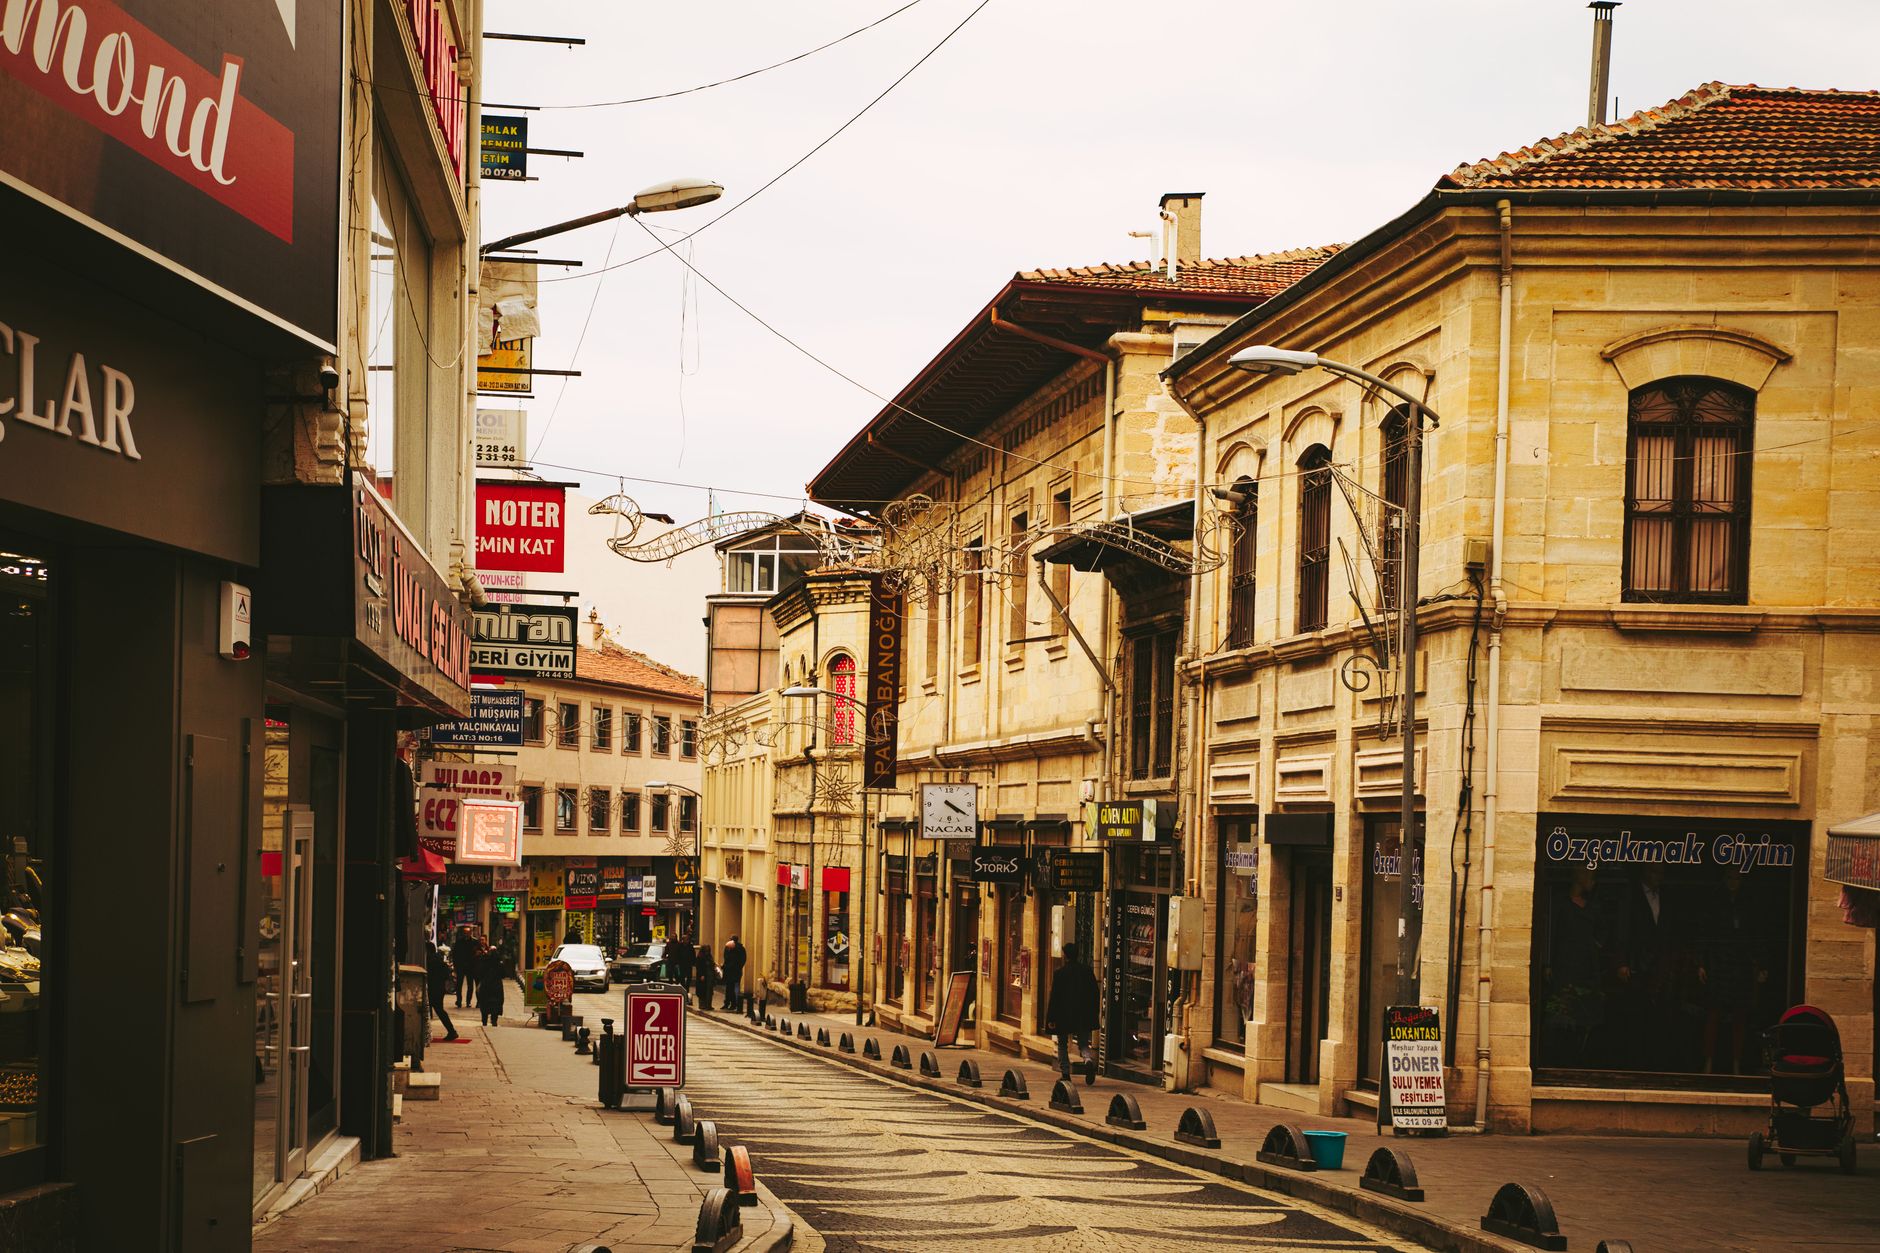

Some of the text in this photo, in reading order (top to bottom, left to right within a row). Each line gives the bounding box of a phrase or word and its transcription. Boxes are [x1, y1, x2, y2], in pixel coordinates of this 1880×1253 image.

[486, 445, 499, 453] 28
[502, 454, 515, 462] 98
[485, 499, 560, 528] NOTER
[520, 538, 555, 555] KAT
[515, 650, 570, 669] GİYİM
[480, 707, 520, 722] MÜŞAVİR
[458, 722, 520, 734] YALÇINKAYALI
[924, 825, 974, 833] NACAR
[1546, 826, 1705, 871] Özçakmak
[1712, 832, 1795, 874] Giyim
[974, 857, 1018, 874] STORKS
[529, 896, 564, 909] ÇORBACI
[644, 1001, 669, 1032] 2.
[1390, 1026, 1438, 1041] LOKANTASI
[634, 1034, 675, 1061] NOTER
[1392, 1053, 1439, 1072] DÖNER
[1392, 1076, 1442, 1089] SULU YEMEK
[1422, 1118, 1432, 1126] 09
[1434, 1118, 1444, 1126] 47
